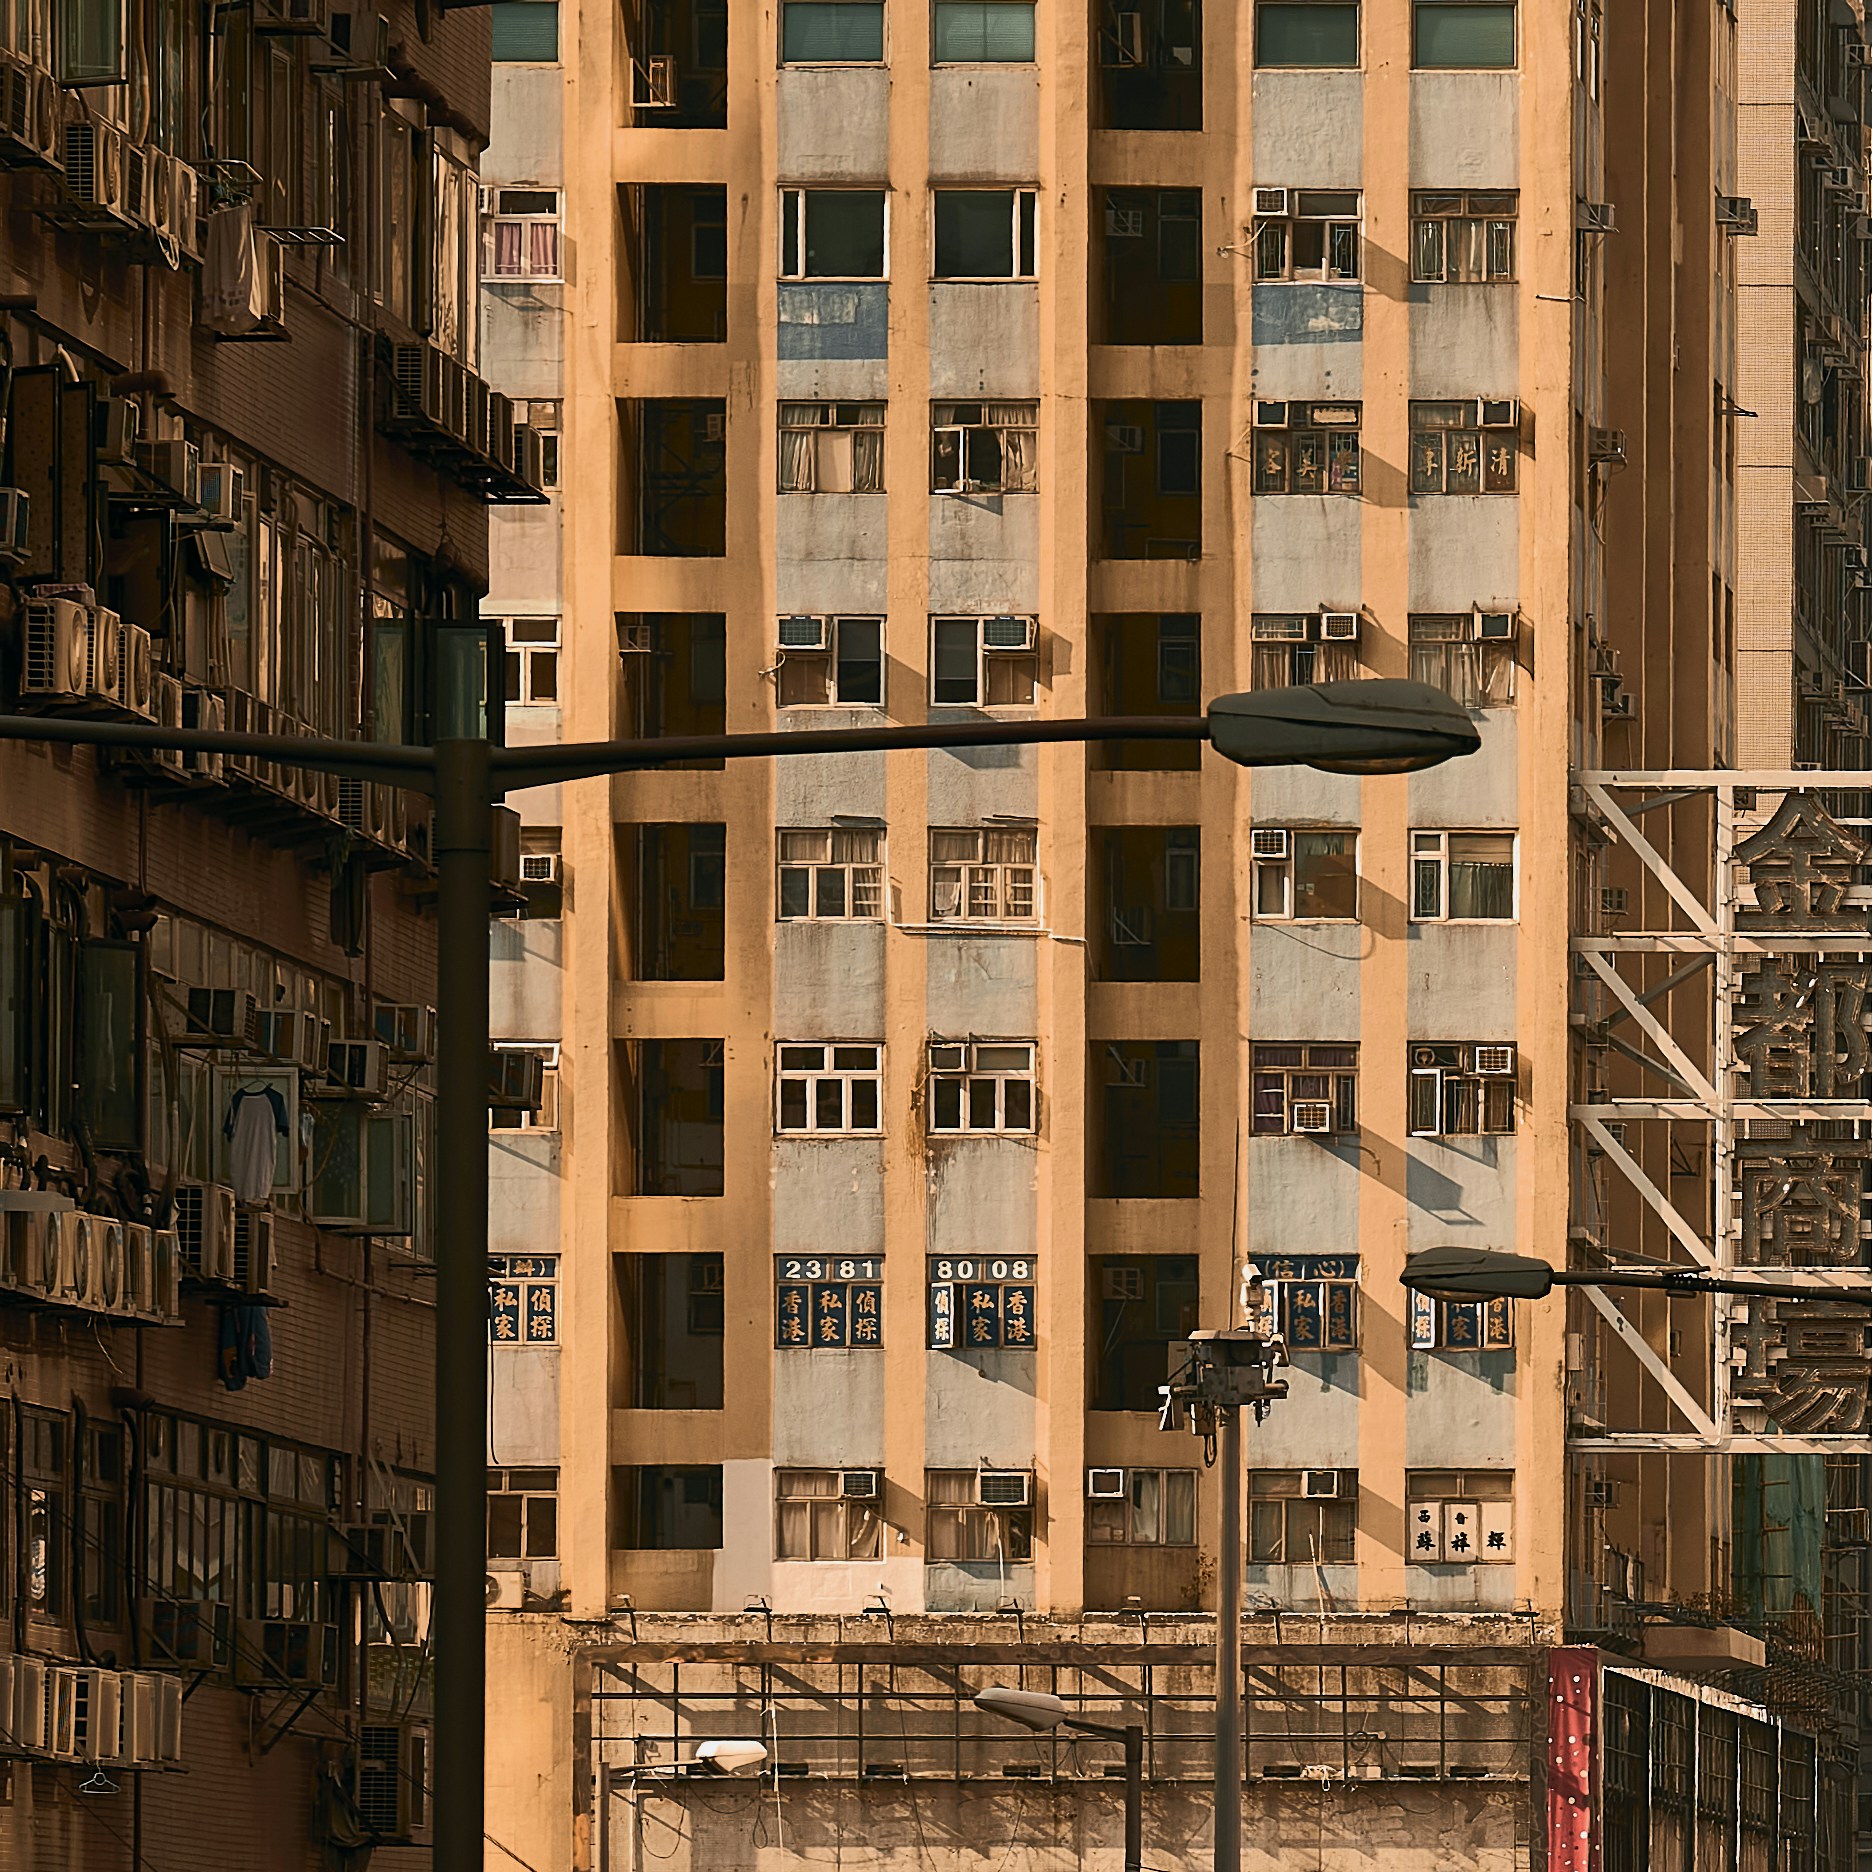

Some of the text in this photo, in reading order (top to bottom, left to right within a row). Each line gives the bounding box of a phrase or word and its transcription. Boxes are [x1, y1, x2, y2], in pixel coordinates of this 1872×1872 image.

[1734, 793, 1872, 1433] 金都商場
[785, 1261, 878, 1281] 23 81
[938, 1261, 1030, 1281] 80 08
[780, 1285, 805, 1344] 香港
[818, 1285, 844, 1342] 私家
[854, 1285, 881, 1342] 偵探
[969, 1285, 995, 1343] 私家
[1006, 1285, 1031, 1343] 香港
[1293, 1287, 1317, 1341] 私家
[1329, 1289, 1350, 1340] 香港
